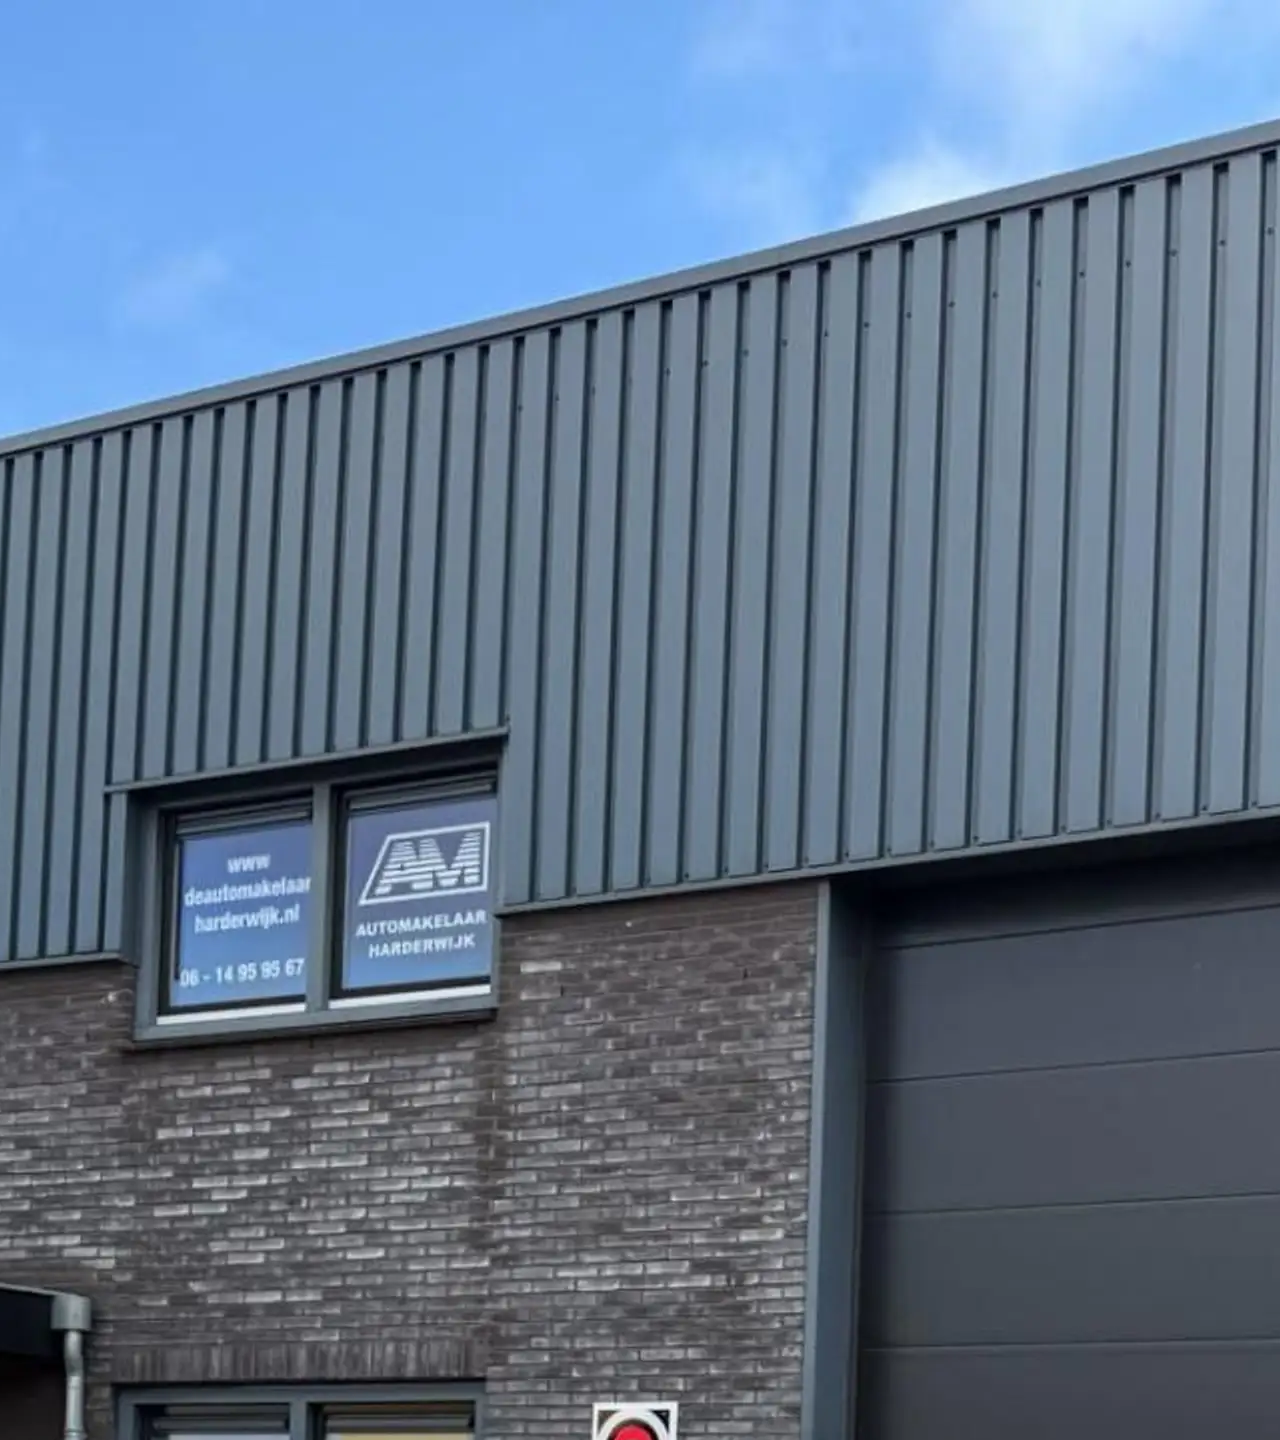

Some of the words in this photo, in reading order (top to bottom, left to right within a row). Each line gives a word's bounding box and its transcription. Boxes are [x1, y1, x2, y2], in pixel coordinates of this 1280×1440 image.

[227, 854, 271, 873] www
[184, 876, 311, 907] deautomakelaar
[194, 903, 300, 934] harderwijk.nl
[356, 909, 486, 937] AUTOMAKELAAR
[368, 933, 475, 958] HARDERWIJK
[180, 967, 199, 987] 06
[216, 964, 233, 984] 14
[238, 961, 257, 982] 95
[285, 957, 305, 977] 67
